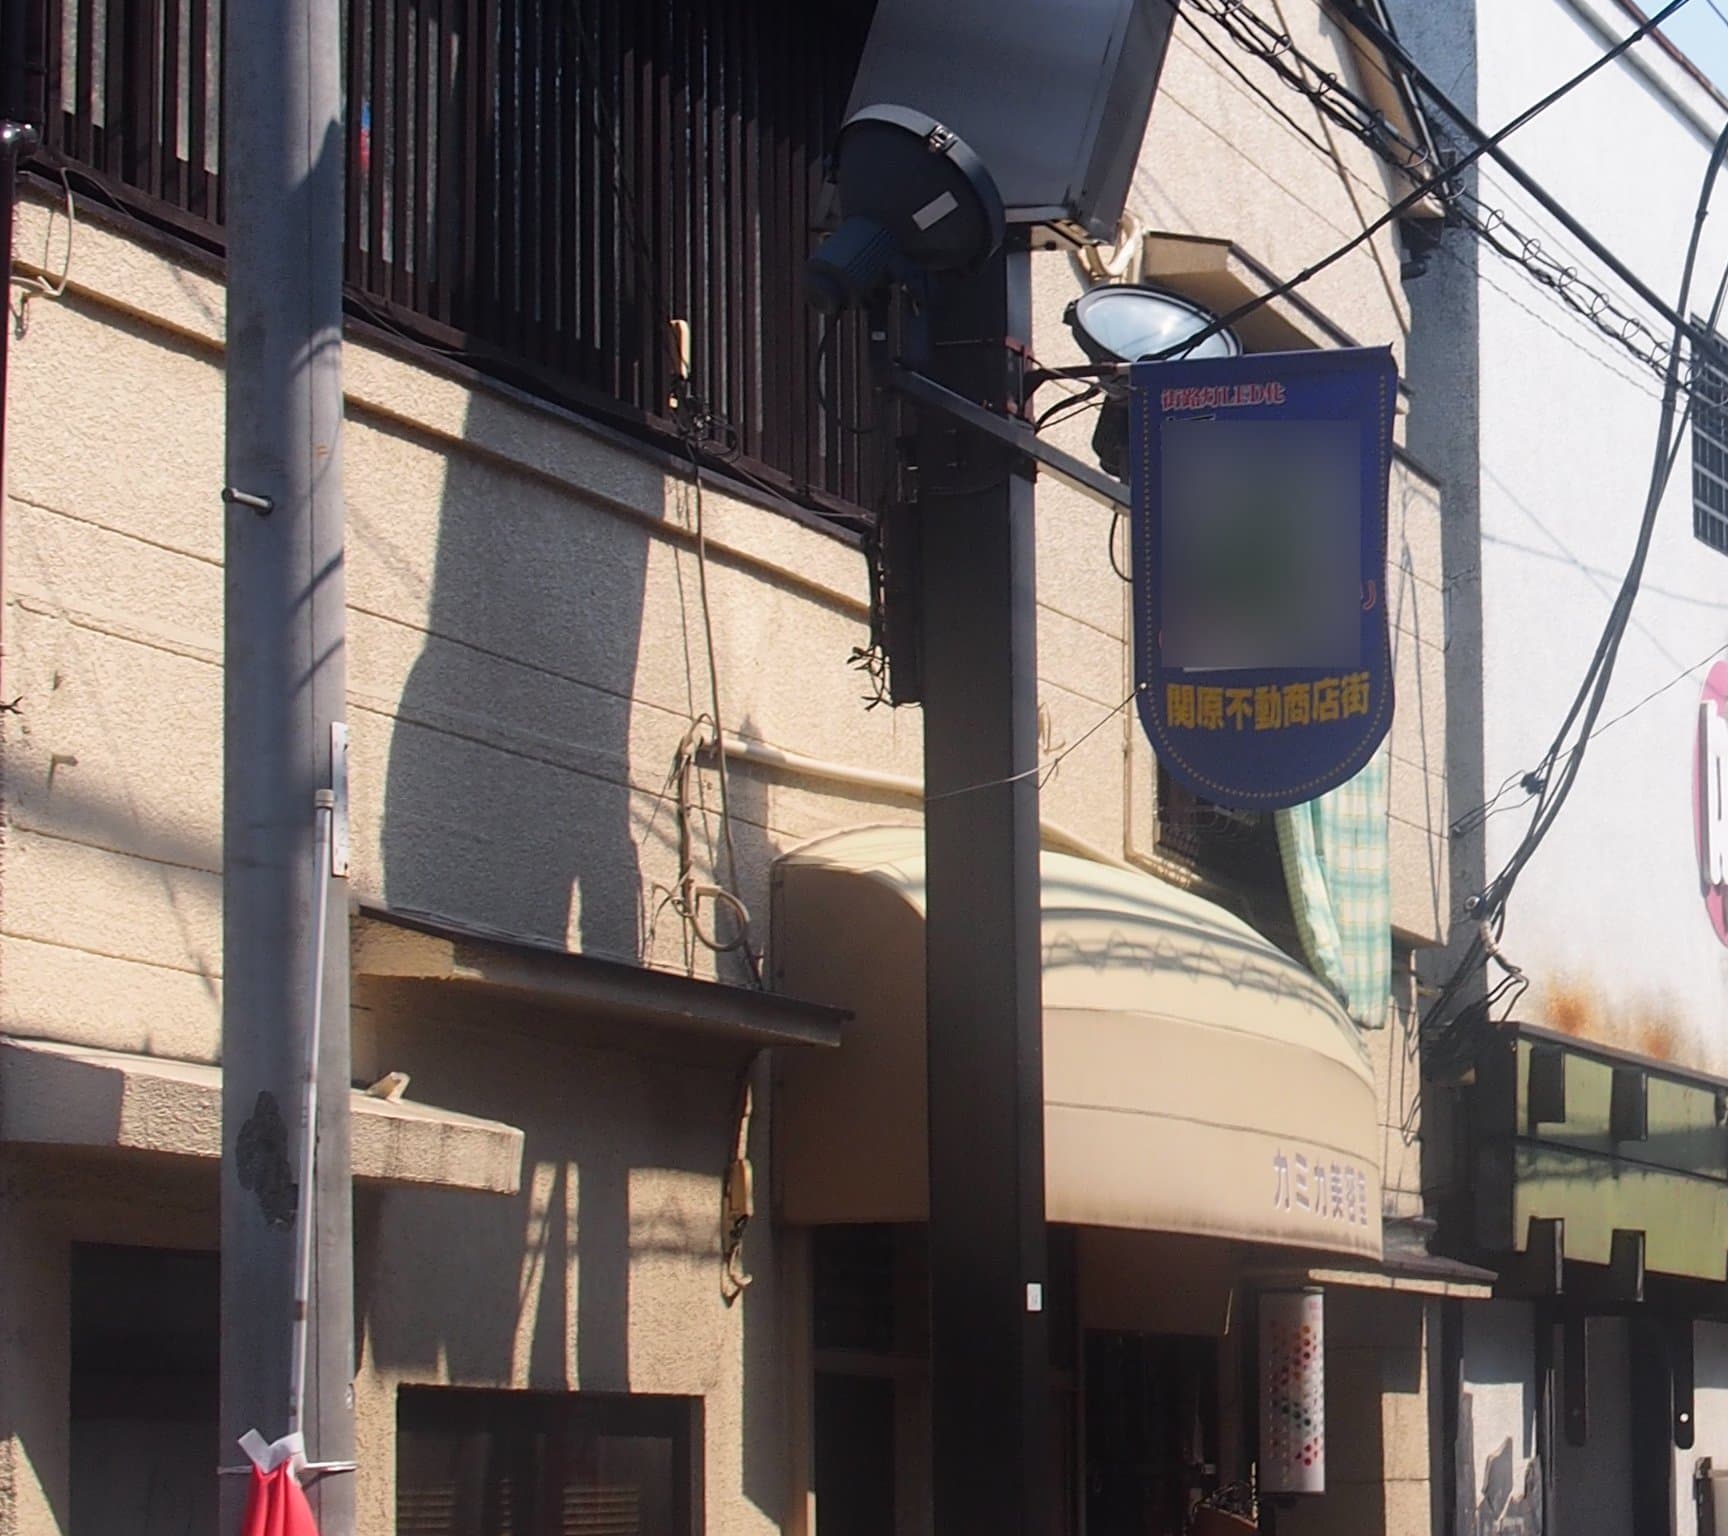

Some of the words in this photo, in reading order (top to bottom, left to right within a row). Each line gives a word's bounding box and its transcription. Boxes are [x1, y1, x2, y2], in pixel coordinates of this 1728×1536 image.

[1166, 670, 1370, 732] 関原不動商店街
